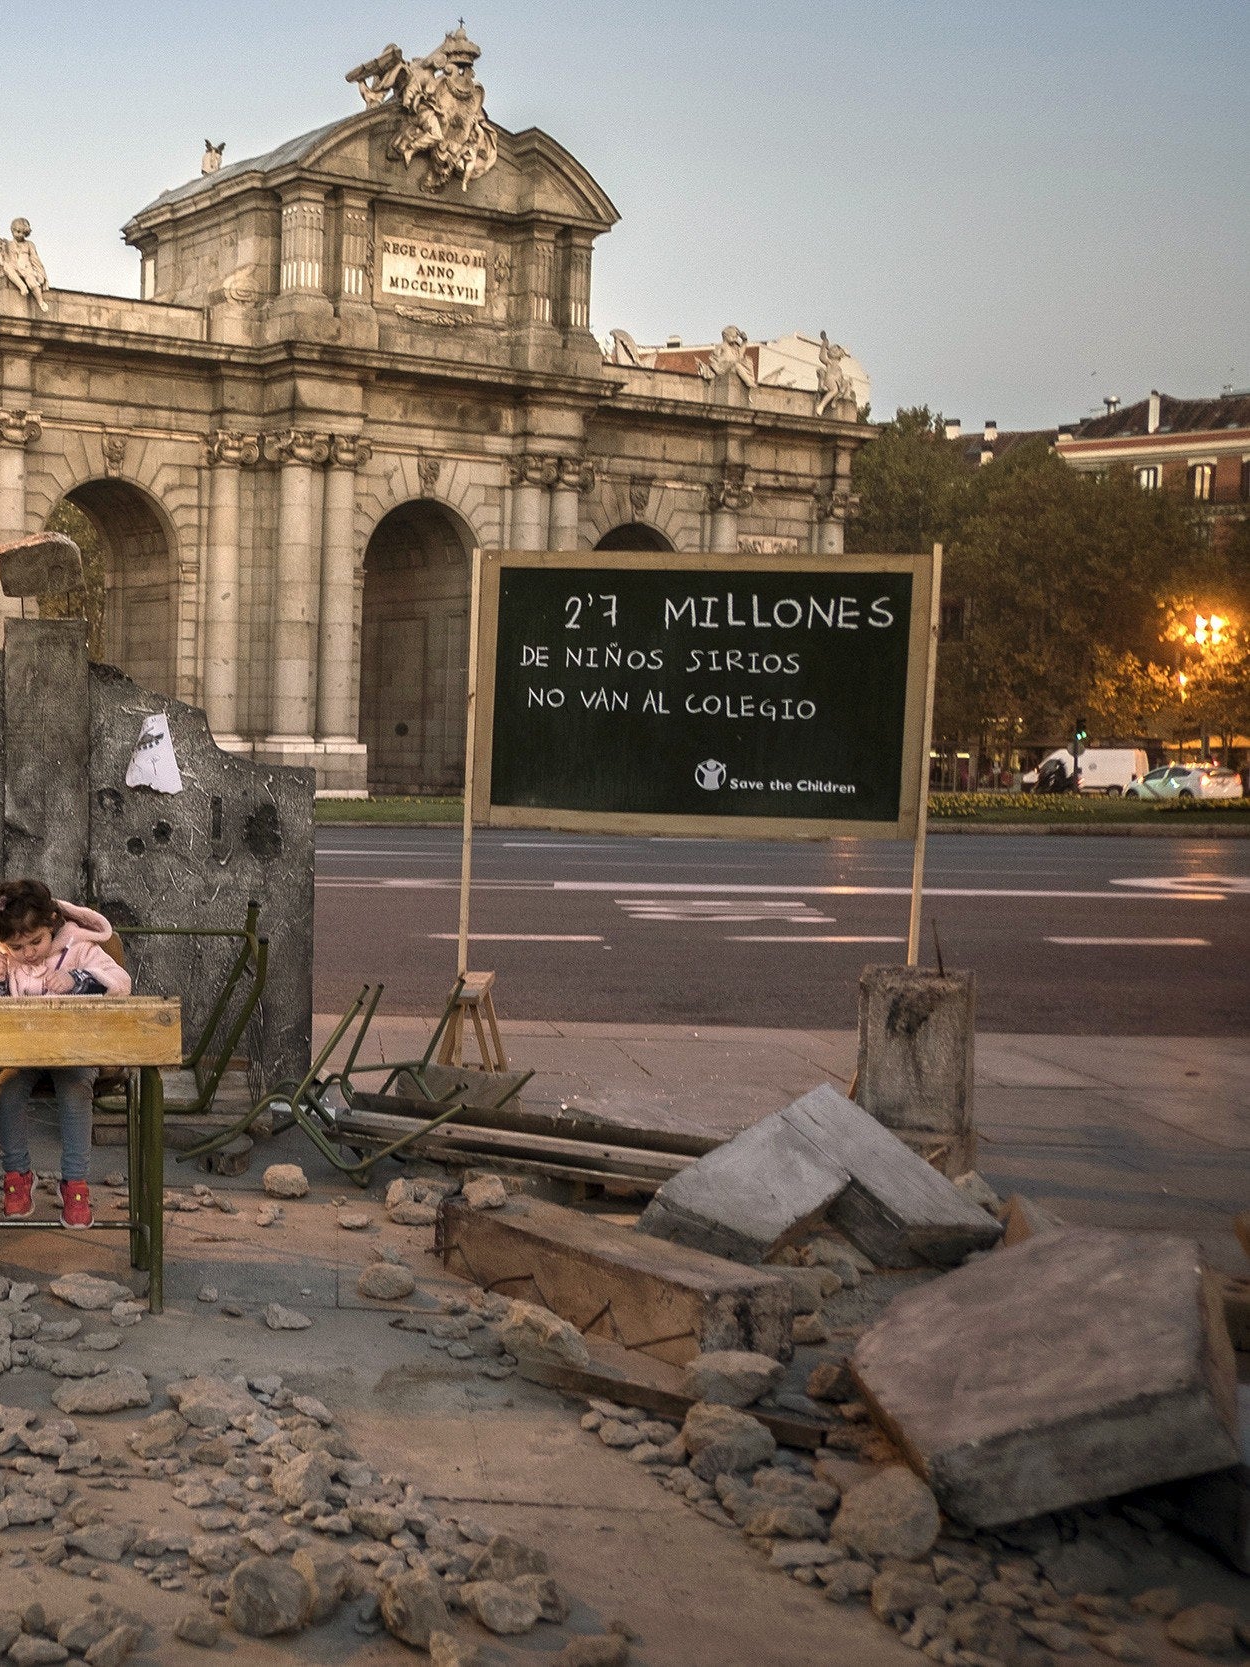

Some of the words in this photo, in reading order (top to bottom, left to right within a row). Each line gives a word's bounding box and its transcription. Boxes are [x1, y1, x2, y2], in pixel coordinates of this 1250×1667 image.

[384, 241, 416, 258] REGE
[420, 248, 470, 266] CAROLO
[417, 264, 455, 279] ANNO
[390, 276, 479, 300] MDCCLXXVIII
[565, 593, 618, 630] 2'7
[664, 593, 894, 630] MILLONES
[520, 645, 549, 667] DE
[566, 642, 664, 670] NIÑOS
[686, 649, 800, 675] SIRIOS
[527, 687, 565, 709] NO
[580, 687, 629, 711] VAN
[642, 690, 671, 714] AL
[686, 694, 817, 721] COLEGIO
[730, 778, 764, 791] Save
[770, 779, 792, 791] the
[796, 779, 856, 794] Children
